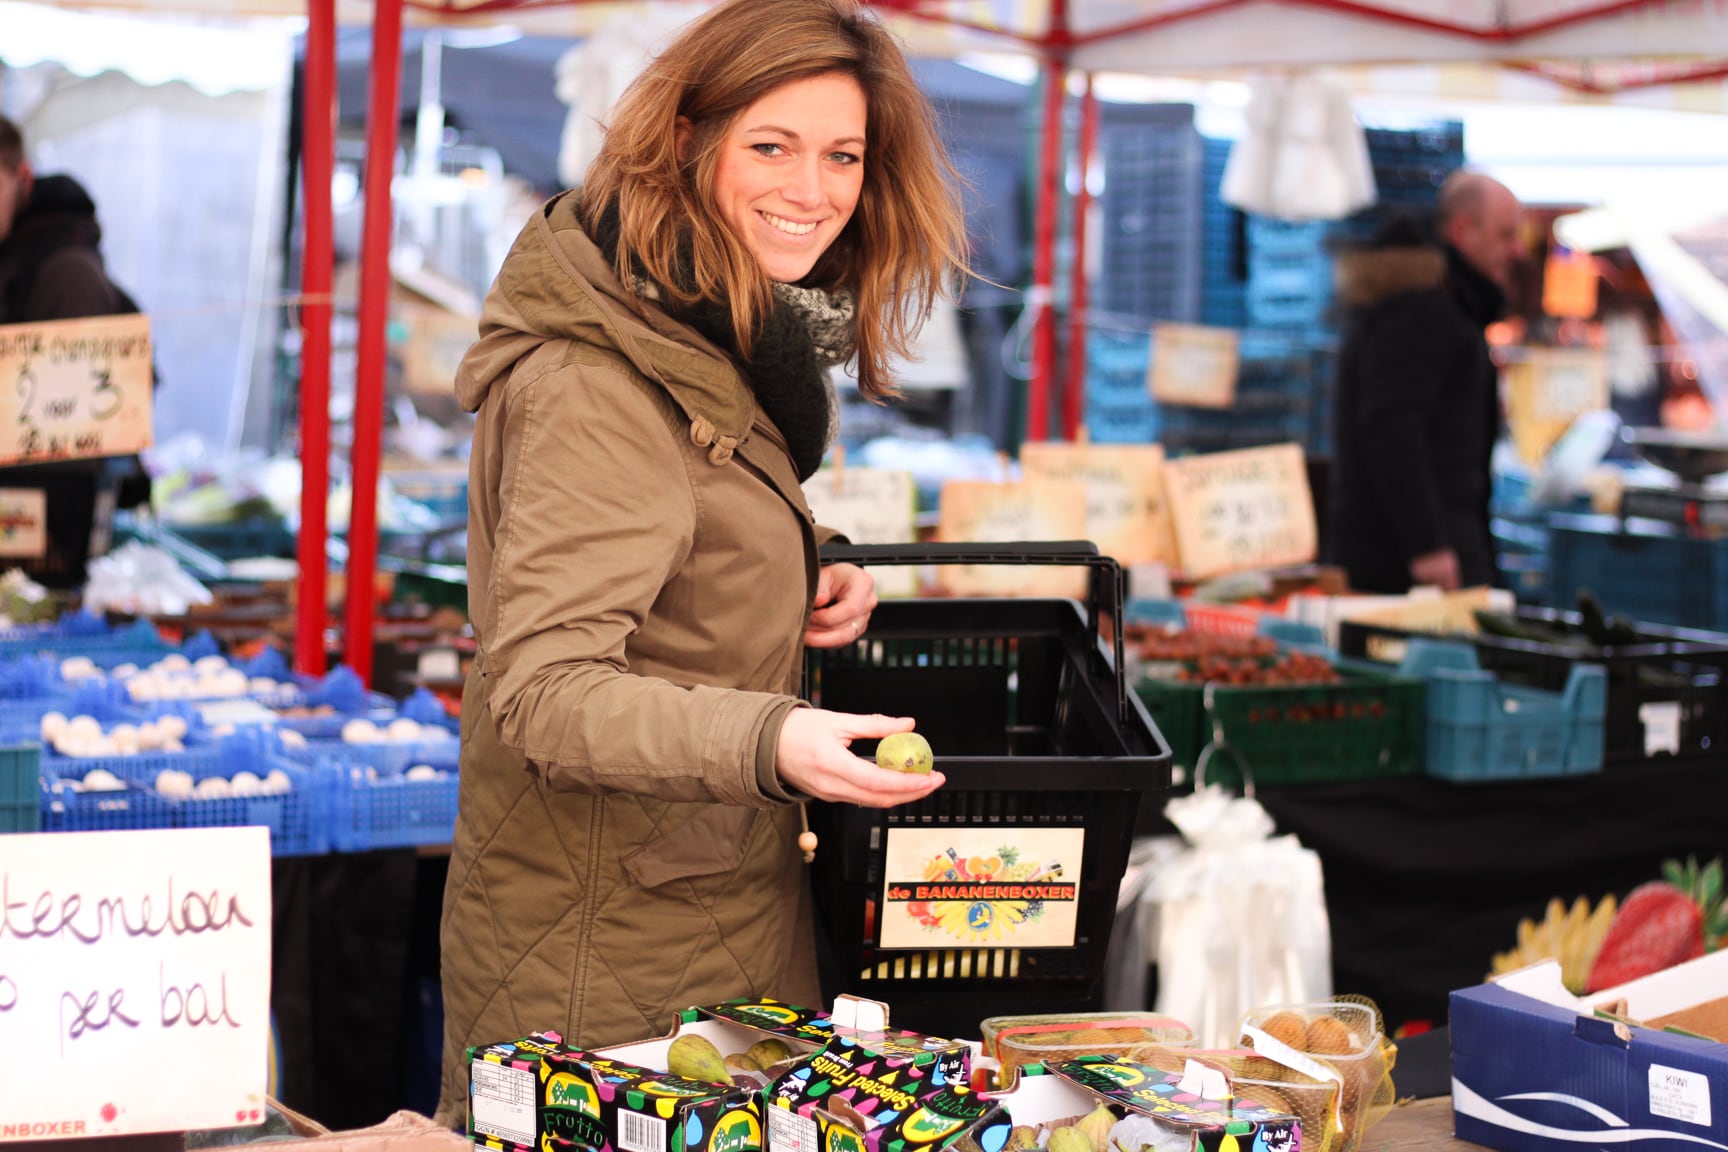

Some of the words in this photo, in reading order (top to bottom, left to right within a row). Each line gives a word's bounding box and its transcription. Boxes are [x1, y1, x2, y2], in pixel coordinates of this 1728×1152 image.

[888, 887, 911, 899] de
[916, 885, 1075, 899] BANANENBOXER
[0, 871, 254, 945] termeloen
[59, 989, 141, 1058] per
[160, 958, 241, 1029] bal
[810, 1056, 857, 1086] Fruits
[939, 1062, 948, 1073] By
[949, 1060, 961, 1070] Air
[847, 1075, 916, 1111] Selected
[1665, 1074, 1688, 1088] KIWI
[0, 1120, 87, 1138] NBOXER
[544, 1112, 604, 1146] Frutto
[1261, 1130, 1273, 1142] By
[1275, 1129, 1288, 1140] Air
